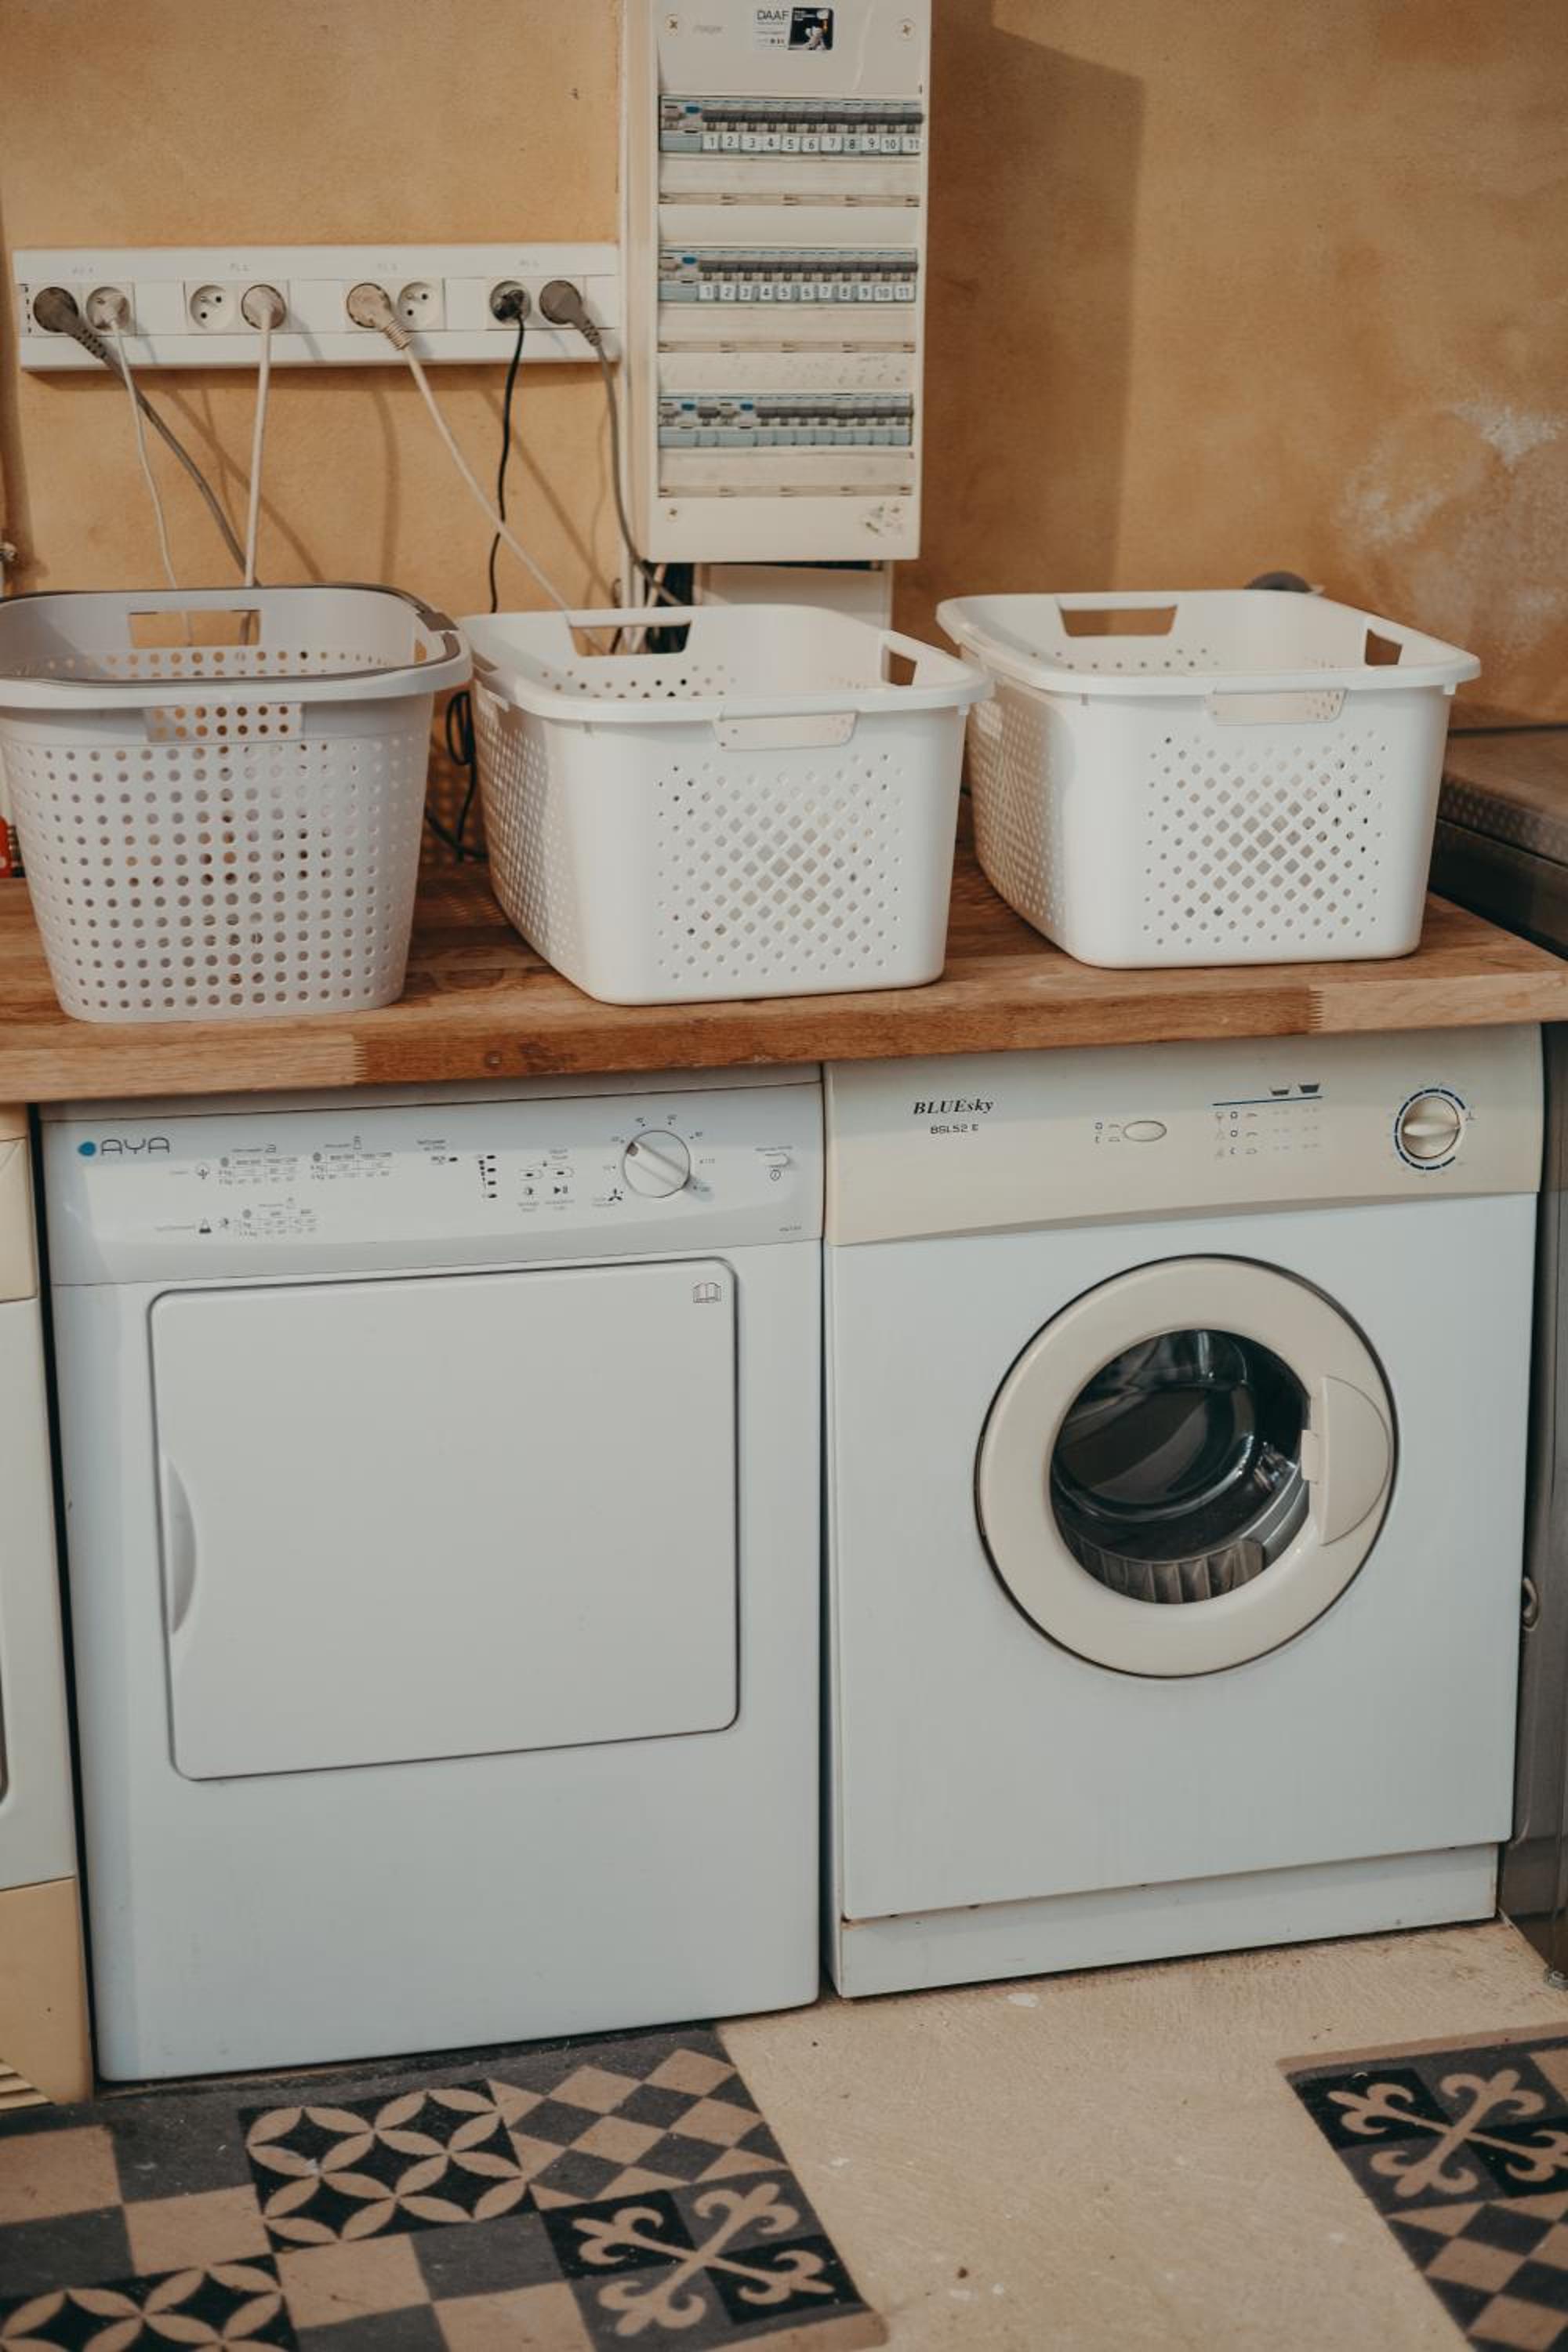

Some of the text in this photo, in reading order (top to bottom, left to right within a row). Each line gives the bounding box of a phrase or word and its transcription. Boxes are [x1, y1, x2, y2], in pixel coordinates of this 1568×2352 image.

[756, 9, 789, 20] DAAF
[728, 136, 733, 147] 2
[750, 138, 755, 147] 3
[768, 138, 774, 147] 4
[787, 140, 793, 149] 5
[809, 140, 815, 149] 6
[830, 139, 835, 147] 7
[850, 140, 855, 148] 8
[869, 139, 874, 147] 9
[885, 140, 896, 149] 10
[909, 140, 919, 149] 11
[100, 1136, 170, 1156] AYA
